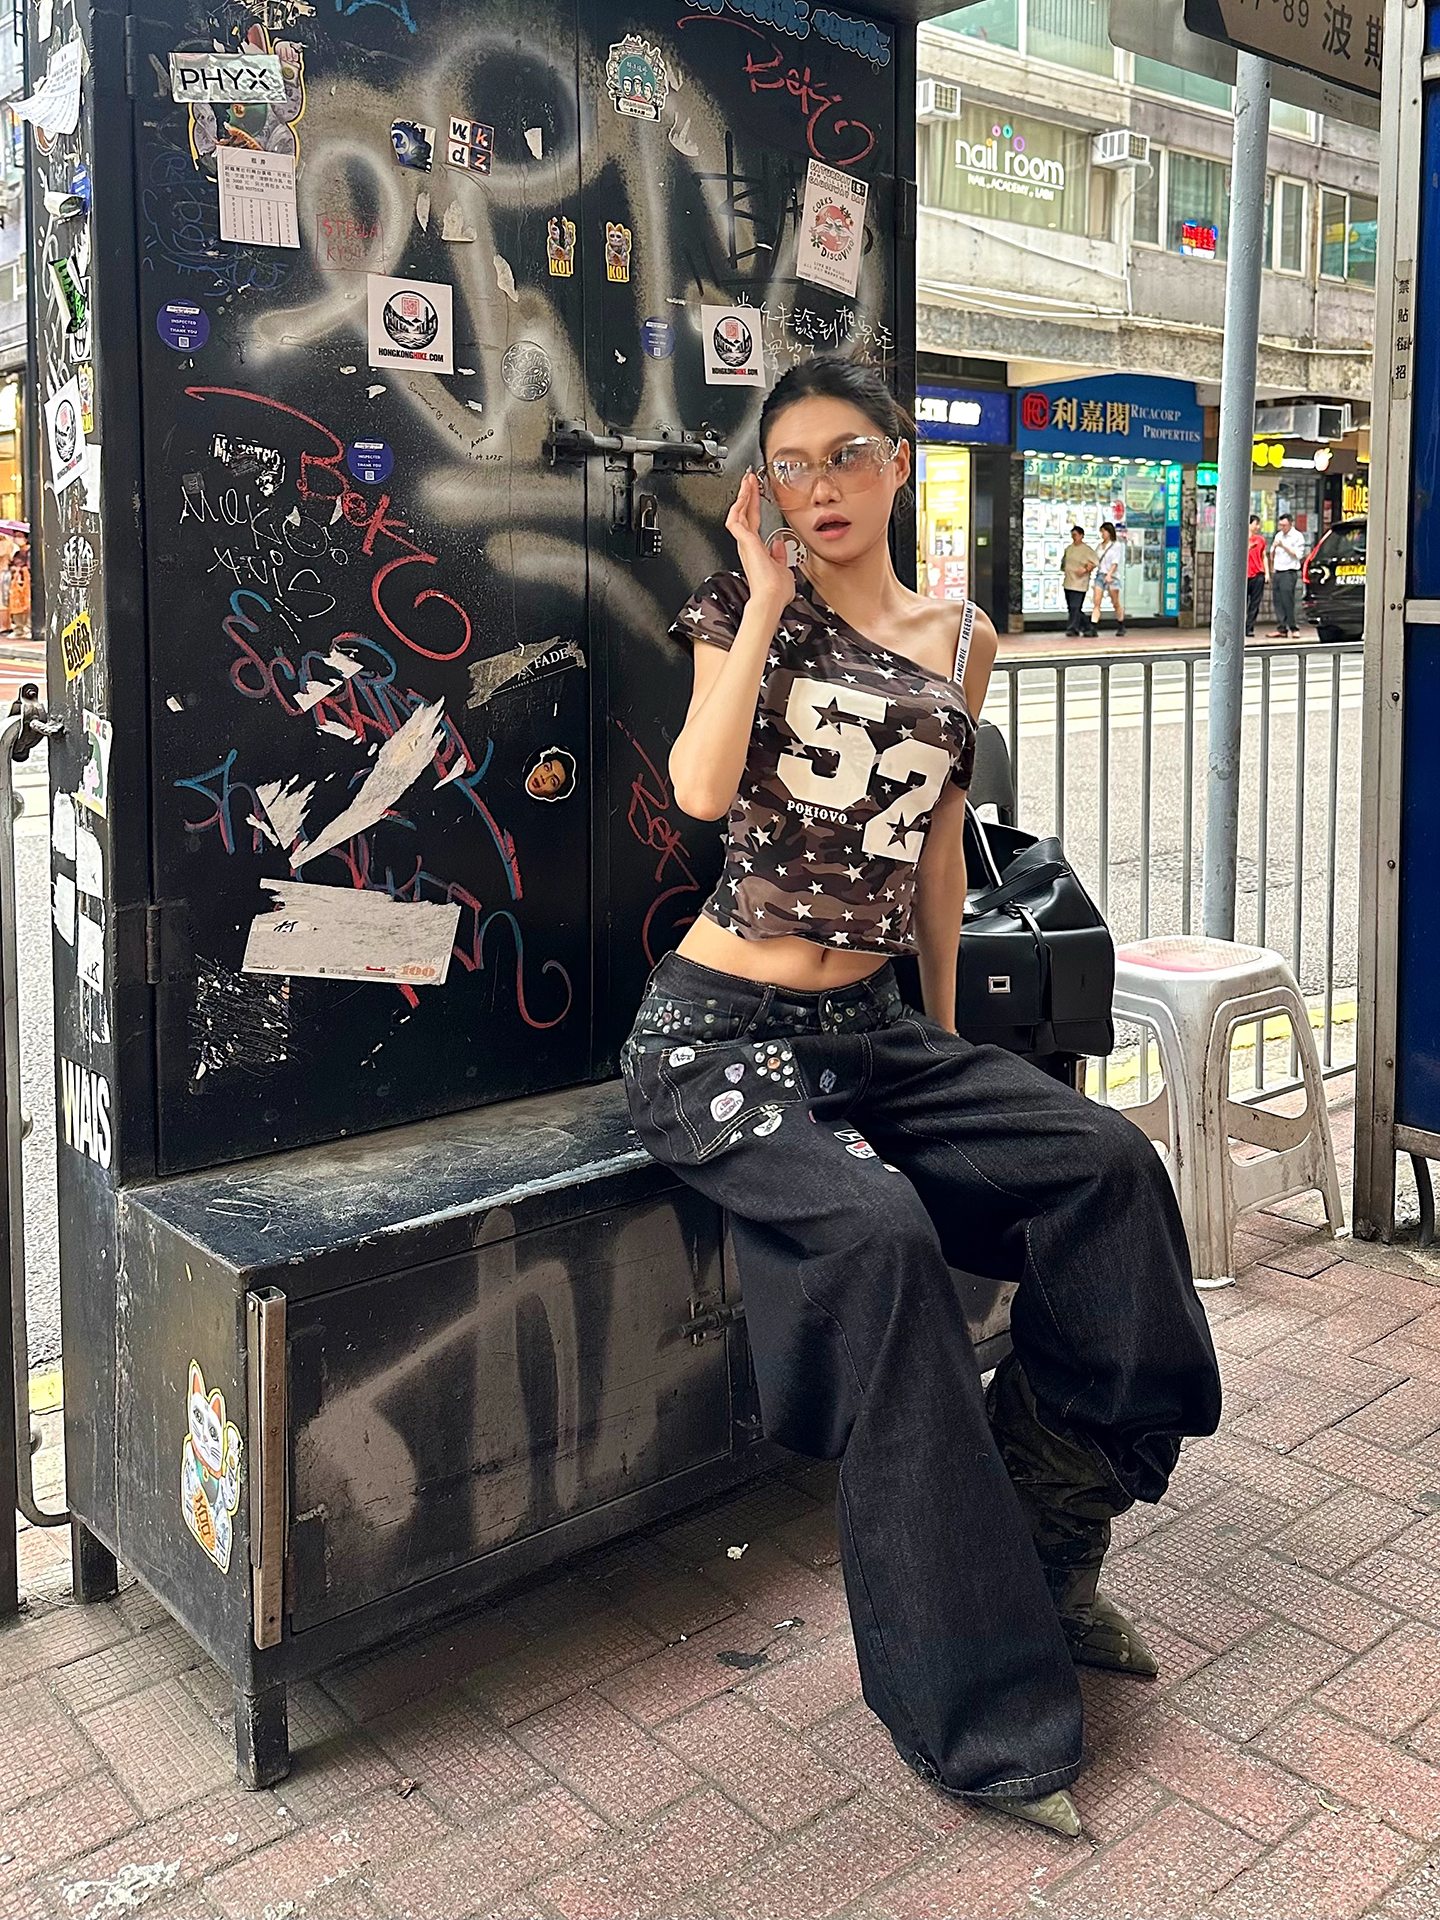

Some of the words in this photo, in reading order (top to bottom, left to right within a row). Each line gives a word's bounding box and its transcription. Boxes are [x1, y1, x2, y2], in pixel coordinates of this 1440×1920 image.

[180, 68, 270, 90] PHYX
[955, 137, 998, 172] nail
[1004, 150, 1065, 186] room
[550, 259, 572, 275] KOL
[608, 264, 628, 281] KOL
[1395, 279, 1411, 380] 禁貼街招
[378, 347, 444, 363] HONGKONGHIKE.COM
[1051, 397, 1130, 436] 利嘉閣
[1131, 403, 1181, 422] RICACORP
[1142, 425, 1200, 442] PROPERTIES
[961, 607, 973, 640] FREEDOM
[534, 647, 573, 669] FADE
[776, 677, 951, 863] 52
[786, 800, 848, 824] POKIOVO
[400, 965, 436, 977] 100
[61, 1056, 111, 1171] WAIS
